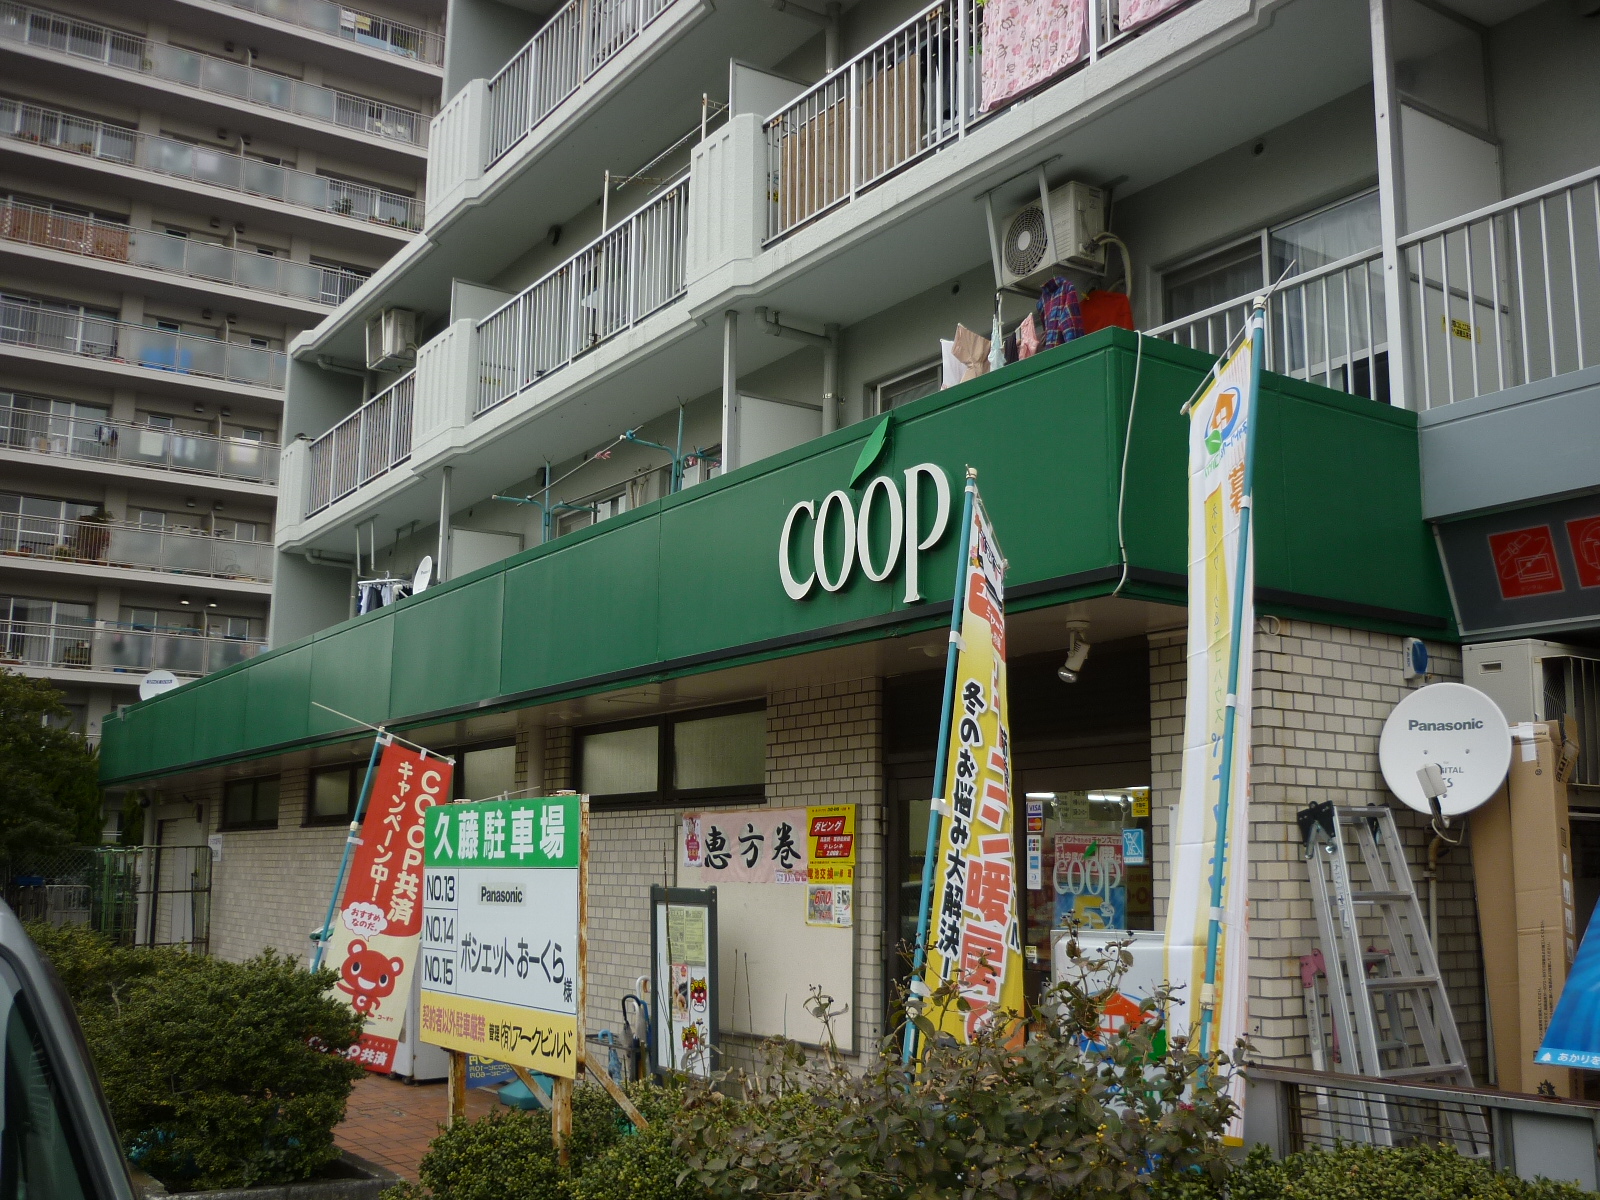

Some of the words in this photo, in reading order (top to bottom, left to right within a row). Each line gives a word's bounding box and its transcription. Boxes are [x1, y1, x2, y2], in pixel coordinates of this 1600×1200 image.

[1408, 718, 1484, 732] Panasonic
[1028, 803, 1043, 812] VISA
[433, 804, 566, 860] 久藤駐車場
[704, 821, 801, 870] 恵方巻
[426, 875, 455, 902] NO.13
[480, 885, 523, 904] Panasonic
[350, 907, 382, 922] おすすめ
[425, 915, 454, 944] NO.14
[424, 954, 453, 986] NO.15
[1557, 1052, 1600, 1066] あかりを
